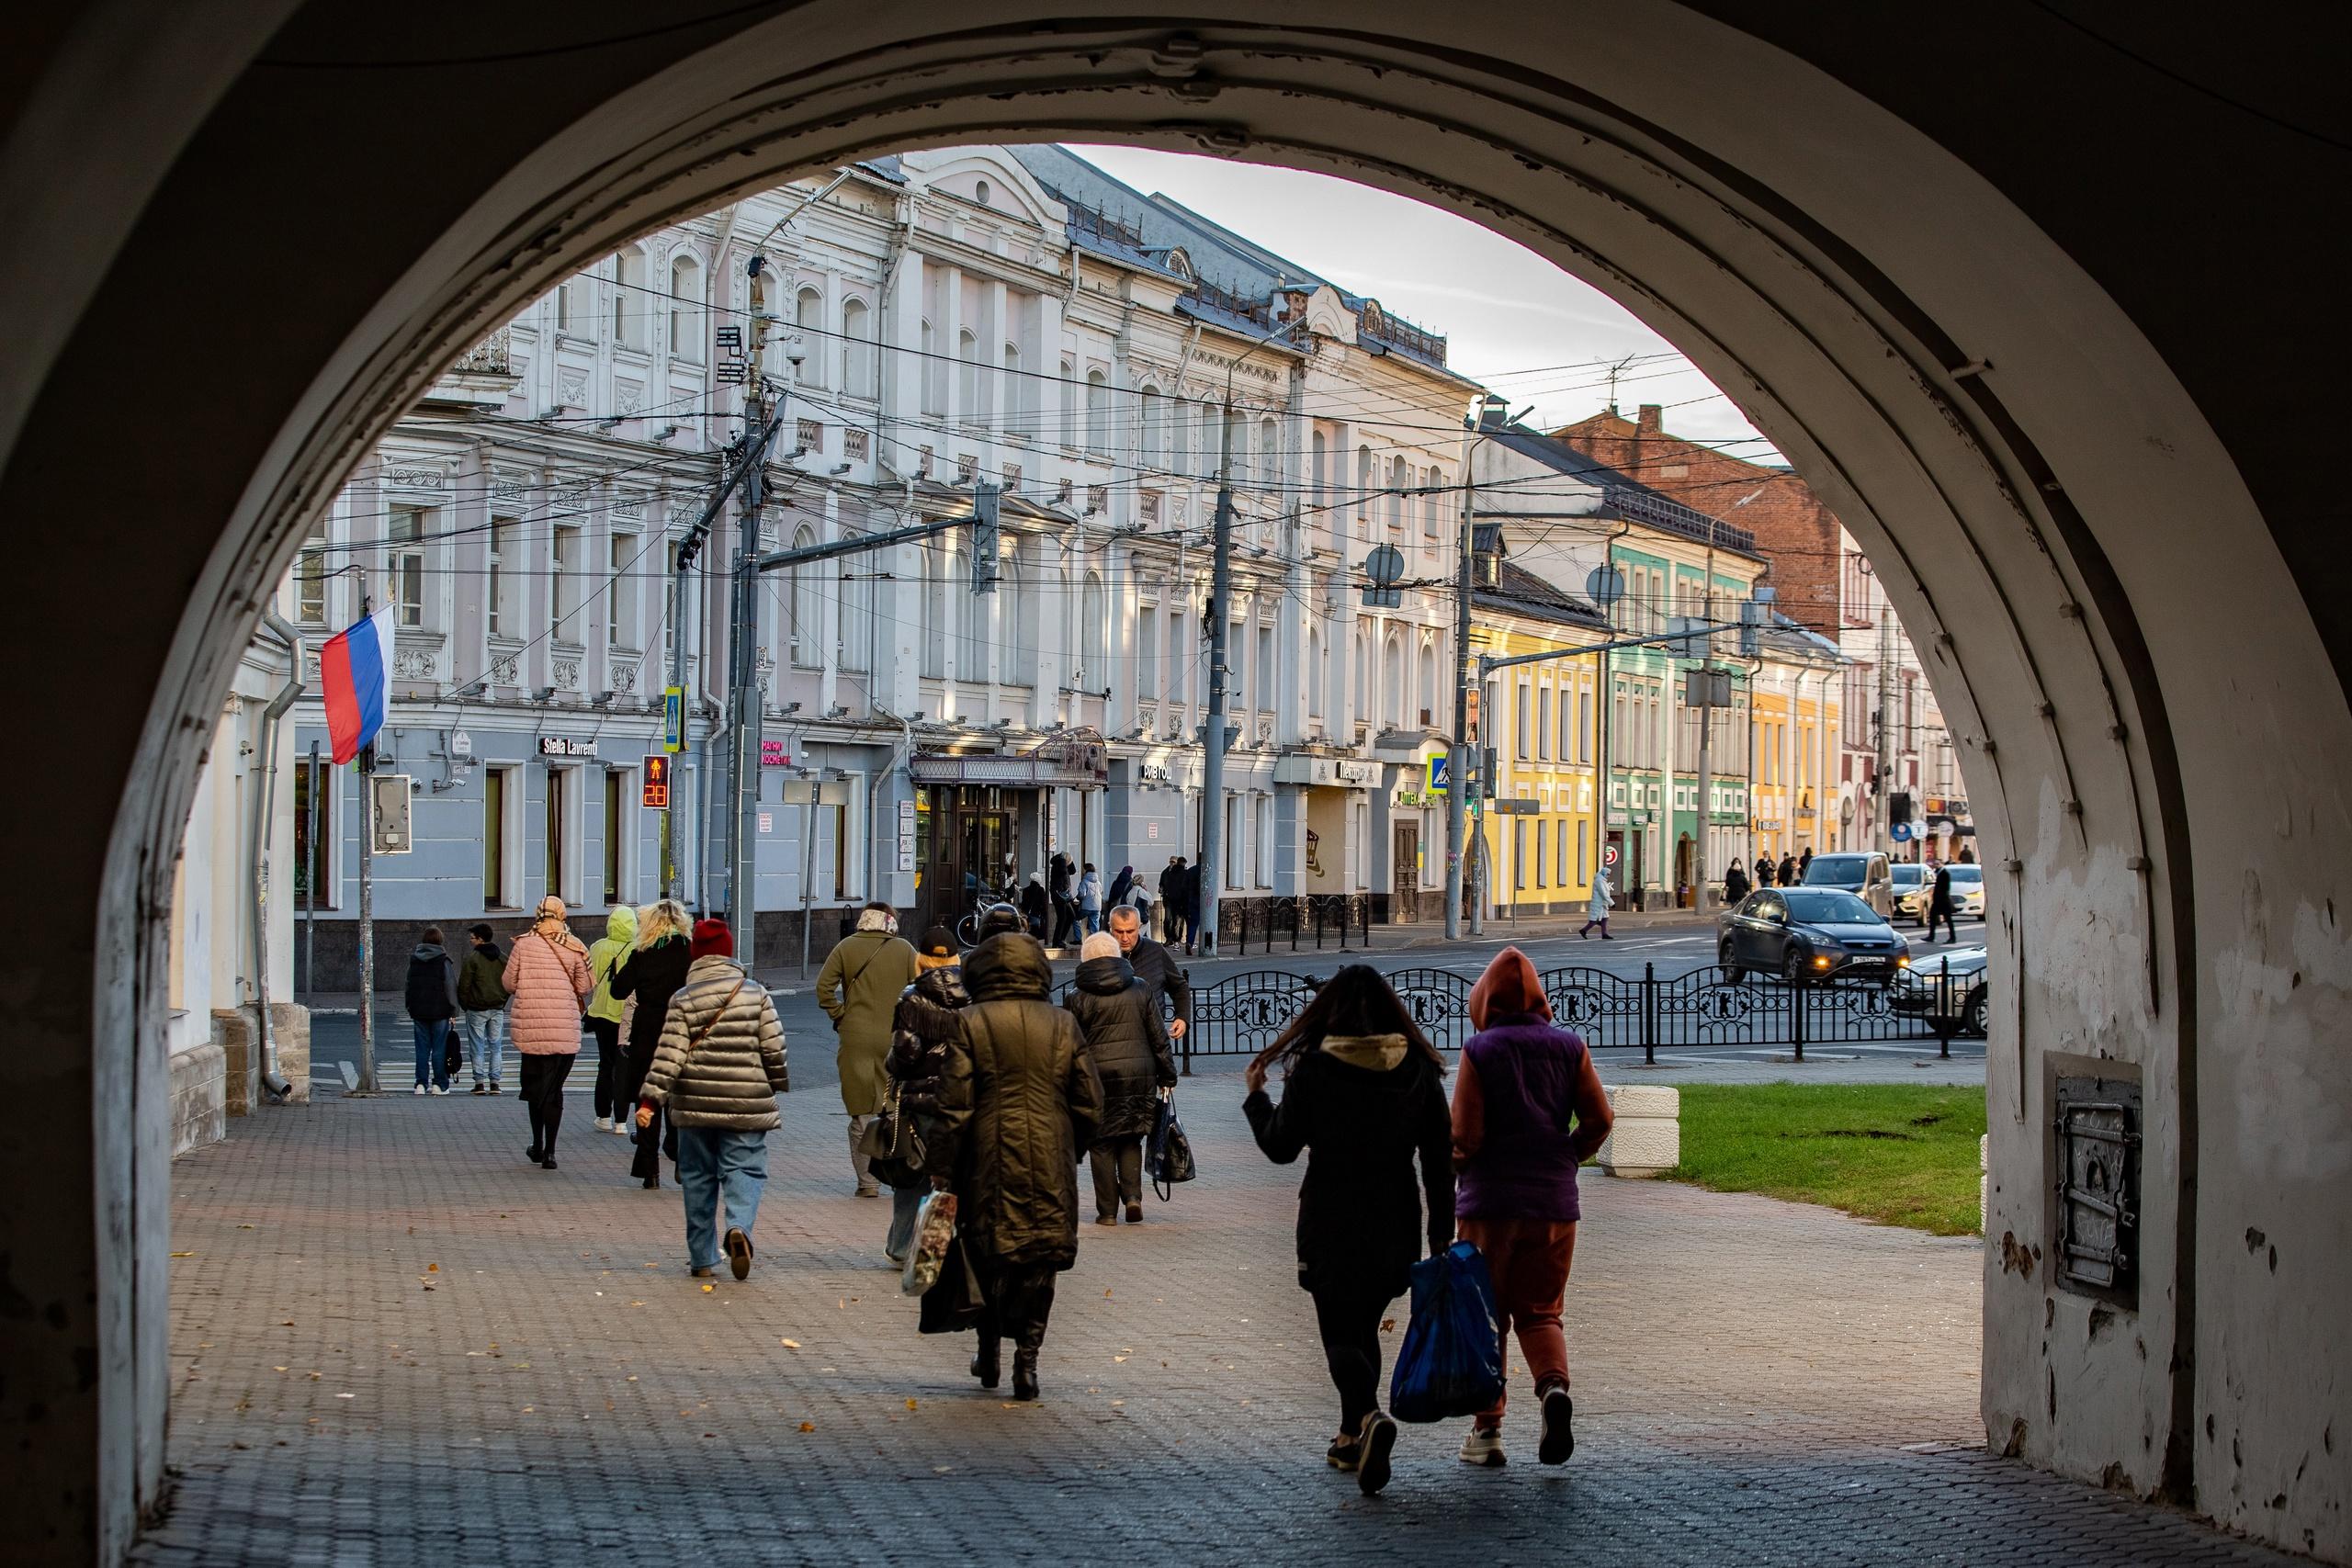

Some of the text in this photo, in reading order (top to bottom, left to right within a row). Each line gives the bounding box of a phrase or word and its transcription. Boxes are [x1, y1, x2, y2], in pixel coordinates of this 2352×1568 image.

[544, 738, 598, 756] Stella Lavrenti
[645, 785, 666, 805] 28
[1401, 792, 1421, 806] АПТЕКА
